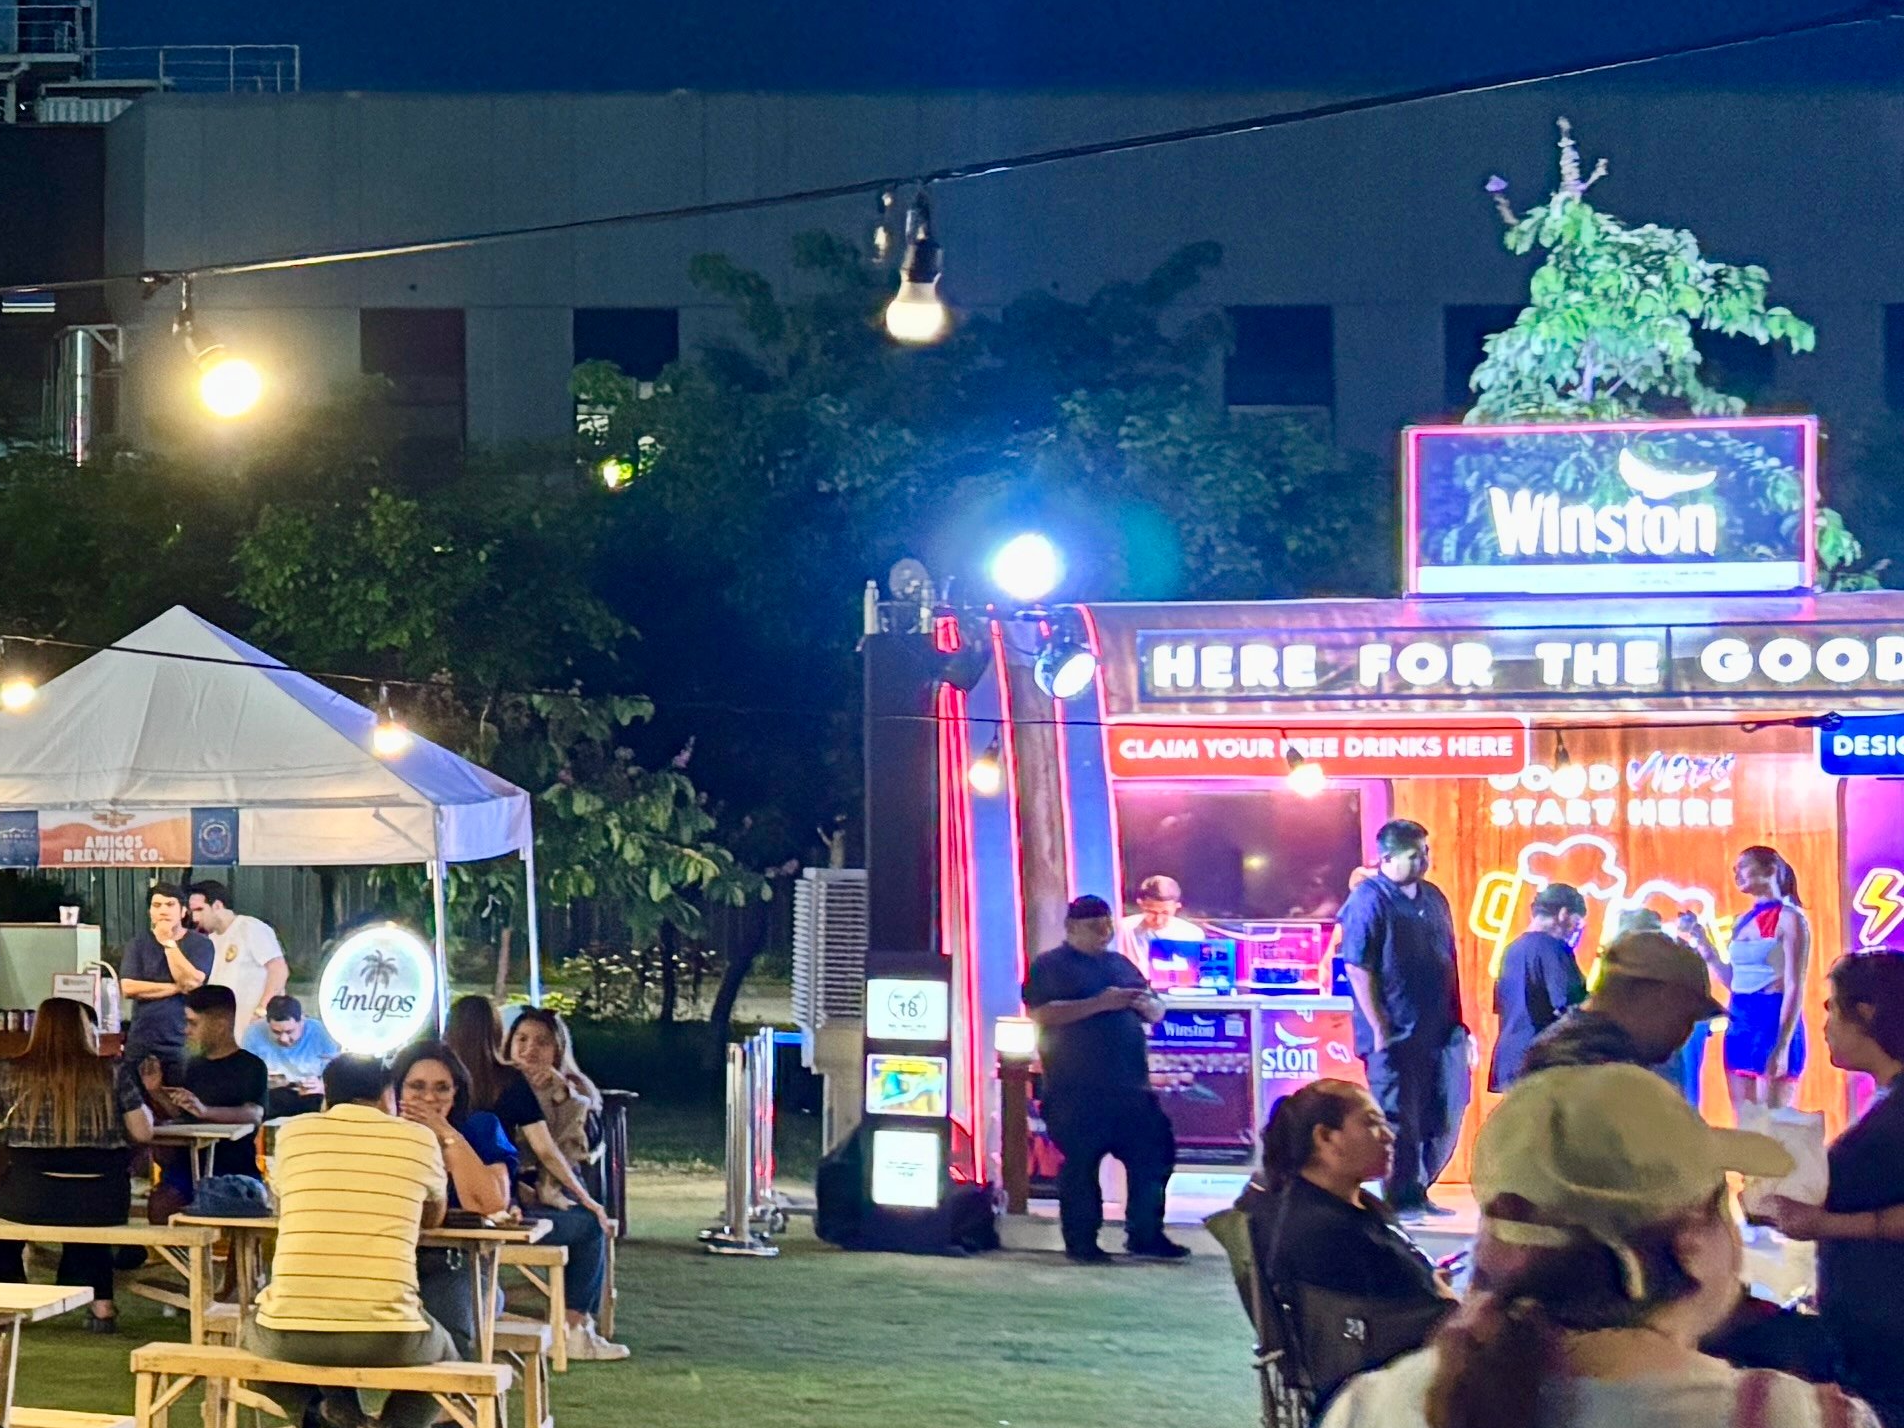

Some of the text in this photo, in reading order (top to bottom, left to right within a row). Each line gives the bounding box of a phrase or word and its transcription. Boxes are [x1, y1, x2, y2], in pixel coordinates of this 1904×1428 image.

[1489, 486, 1718, 556] Winston
[1153, 636, 1904, 688] HERE FOR THE GOOD
[1120, 738, 1199, 759] CLAIM
[1202, 737, 1275, 759] YOUR
[1344, 736, 1442, 758] DRINKS
[1447, 736, 1514, 758] HERE
[1490, 798, 1734, 827] START HERE
[331, 984, 417, 1024] Amigos
[1261, 1044, 1319, 1071] ston
